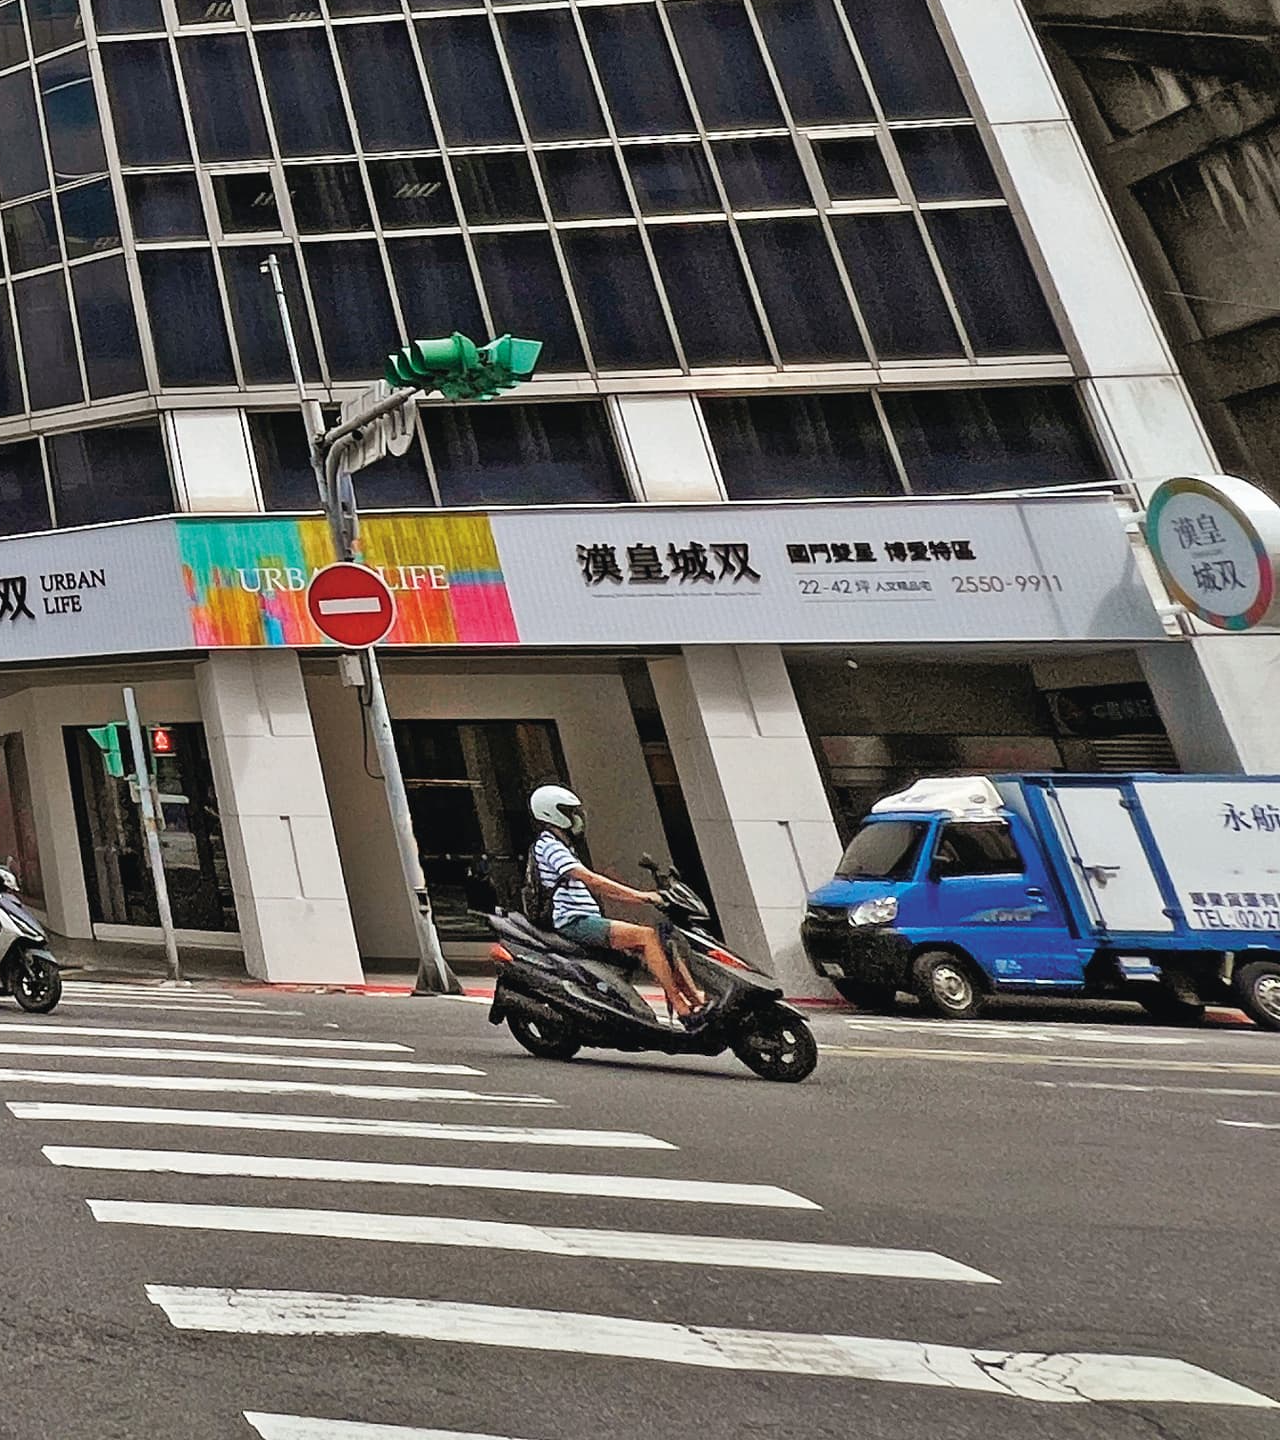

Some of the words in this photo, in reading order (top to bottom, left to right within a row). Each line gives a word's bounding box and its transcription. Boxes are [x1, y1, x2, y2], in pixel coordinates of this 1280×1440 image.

[40, 569, 106, 593] URBAN
[236, 566, 320, 593] URBA
[951, 575, 1063, 593] 2550-9911
[43, 595, 83, 615] LIFE
